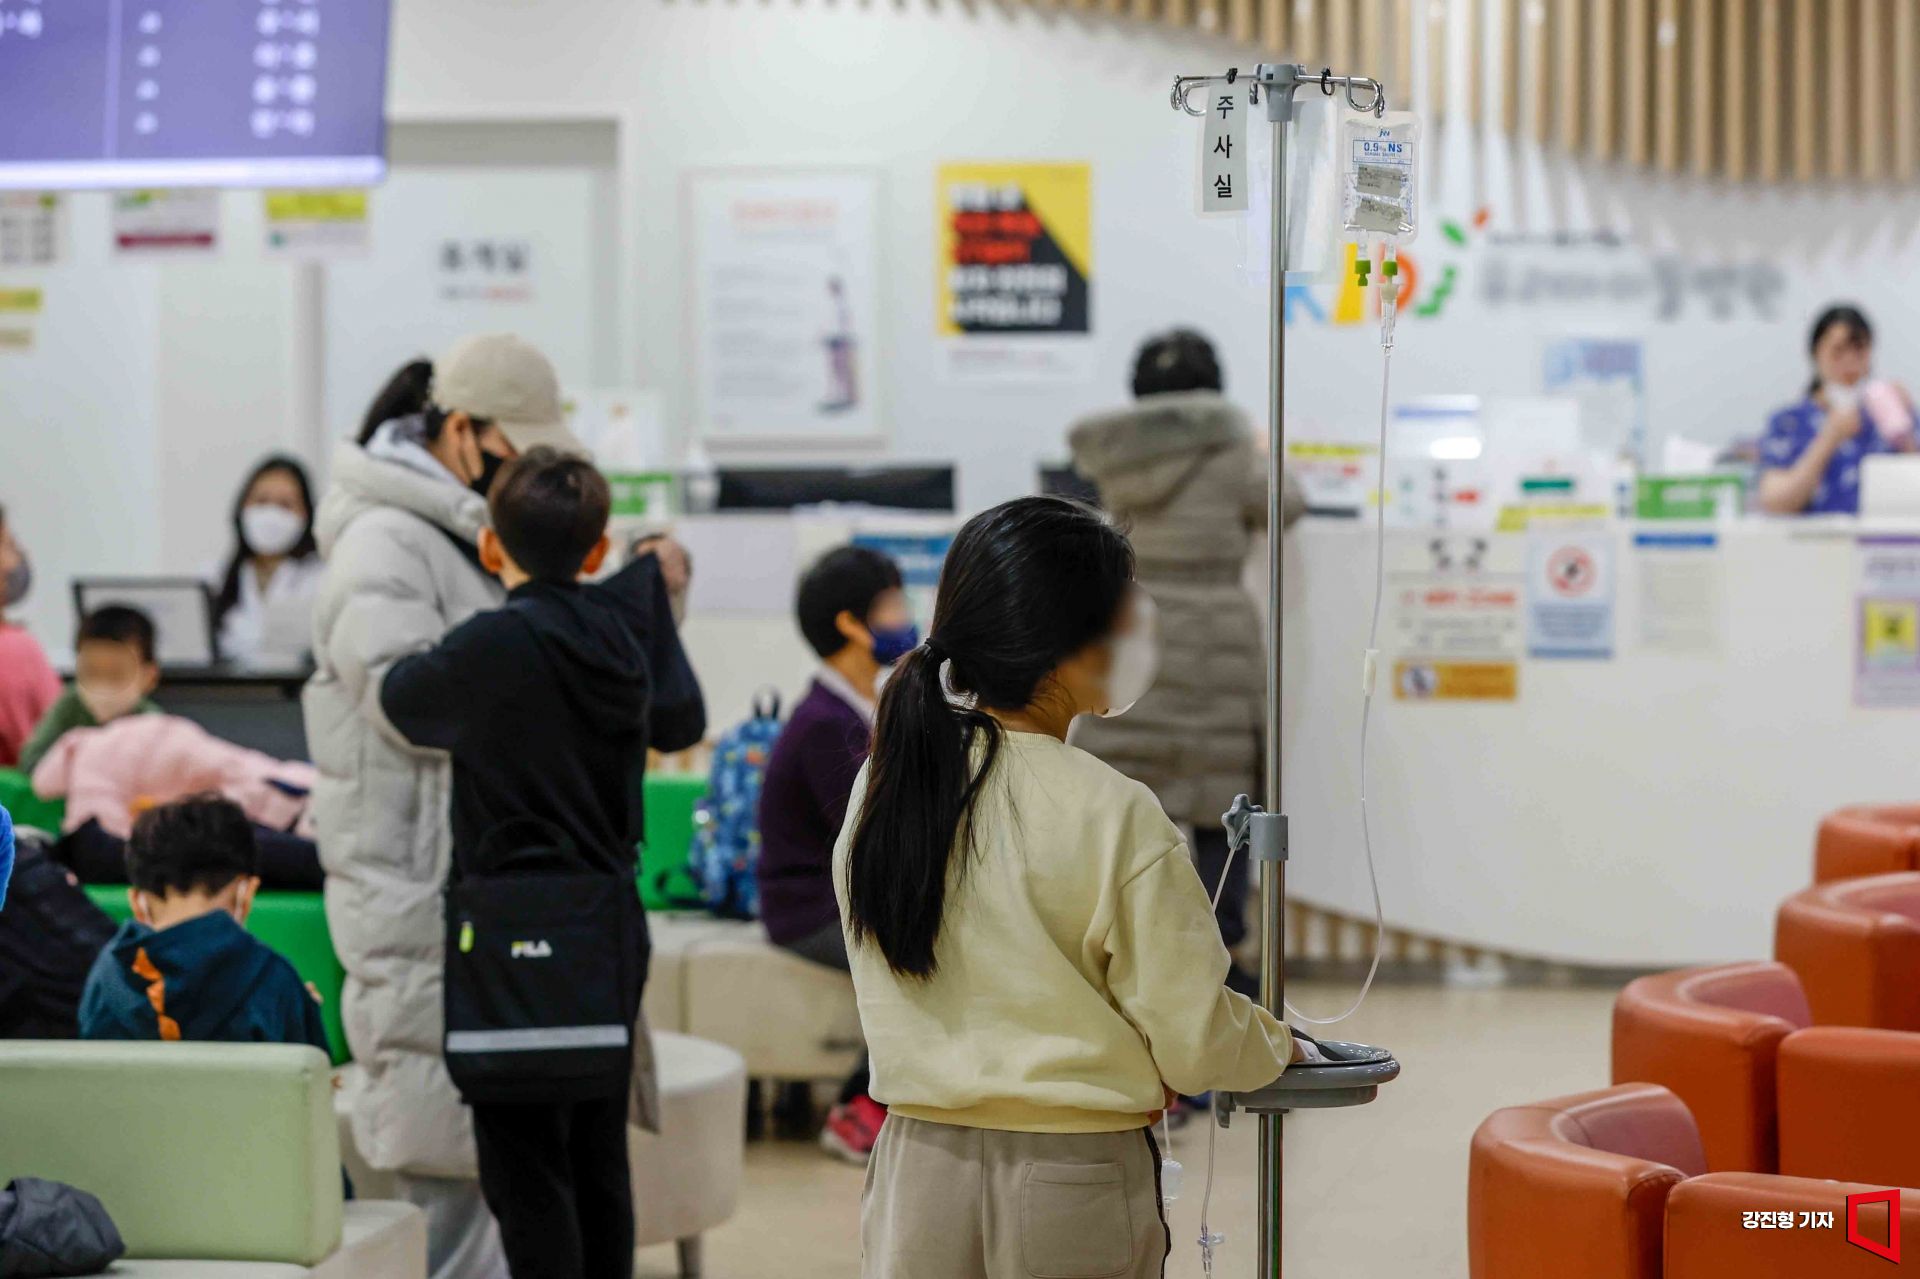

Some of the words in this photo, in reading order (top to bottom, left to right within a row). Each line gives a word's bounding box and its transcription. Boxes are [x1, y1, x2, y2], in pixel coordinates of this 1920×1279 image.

[1213, 95, 1235, 199] 주사실
[1388, 142, 1403, 153] NS
[511, 940, 552, 959] FILA
